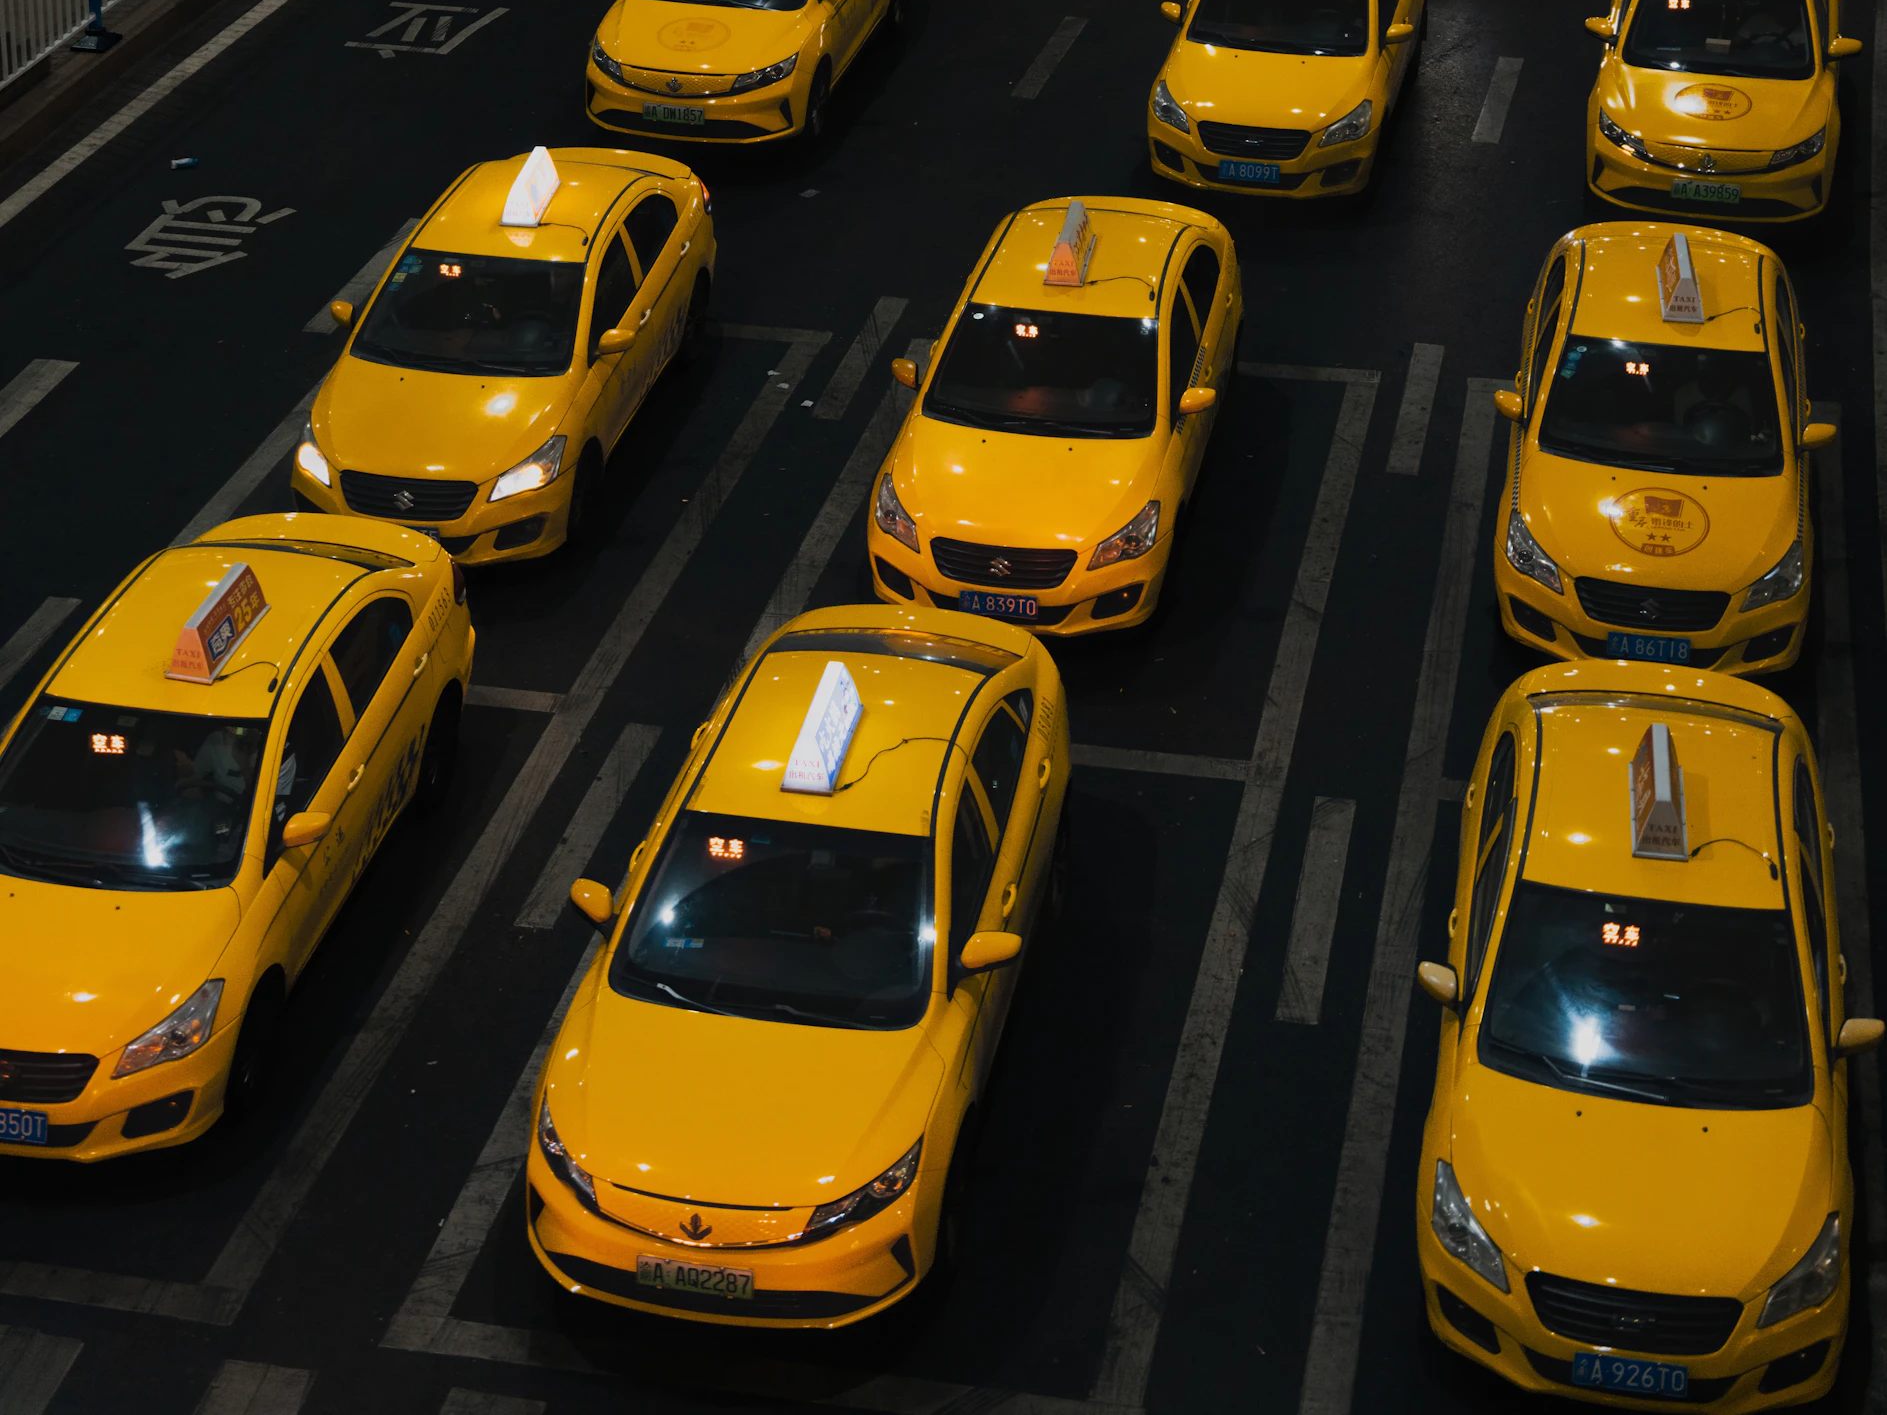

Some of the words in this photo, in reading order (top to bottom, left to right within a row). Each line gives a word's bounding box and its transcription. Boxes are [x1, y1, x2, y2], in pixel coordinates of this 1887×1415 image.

[662, 106, 703, 123] DW1857
[1693, 184, 1740, 202] A39859
[1053, 259, 1074, 267] TAXI
[1673, 295, 1696, 303] TAXI
[1669, 304, 1698, 313] 出租汽车
[176, 648, 200, 658] TAXI
[172, 659, 204, 670] 出租汽车
[91, 733, 126, 751] 空车
[794, 759, 821, 769] TAXI
[788, 769, 825, 781] 出租汽车
[1647, 824, 1678, 834] TAXI
[708, 836, 744, 854] 空车
[1641, 835, 1681, 847] 出租汽车
[1602, 921, 1642, 945] 空车
[675, 1266, 751, 1296] AQ2287
